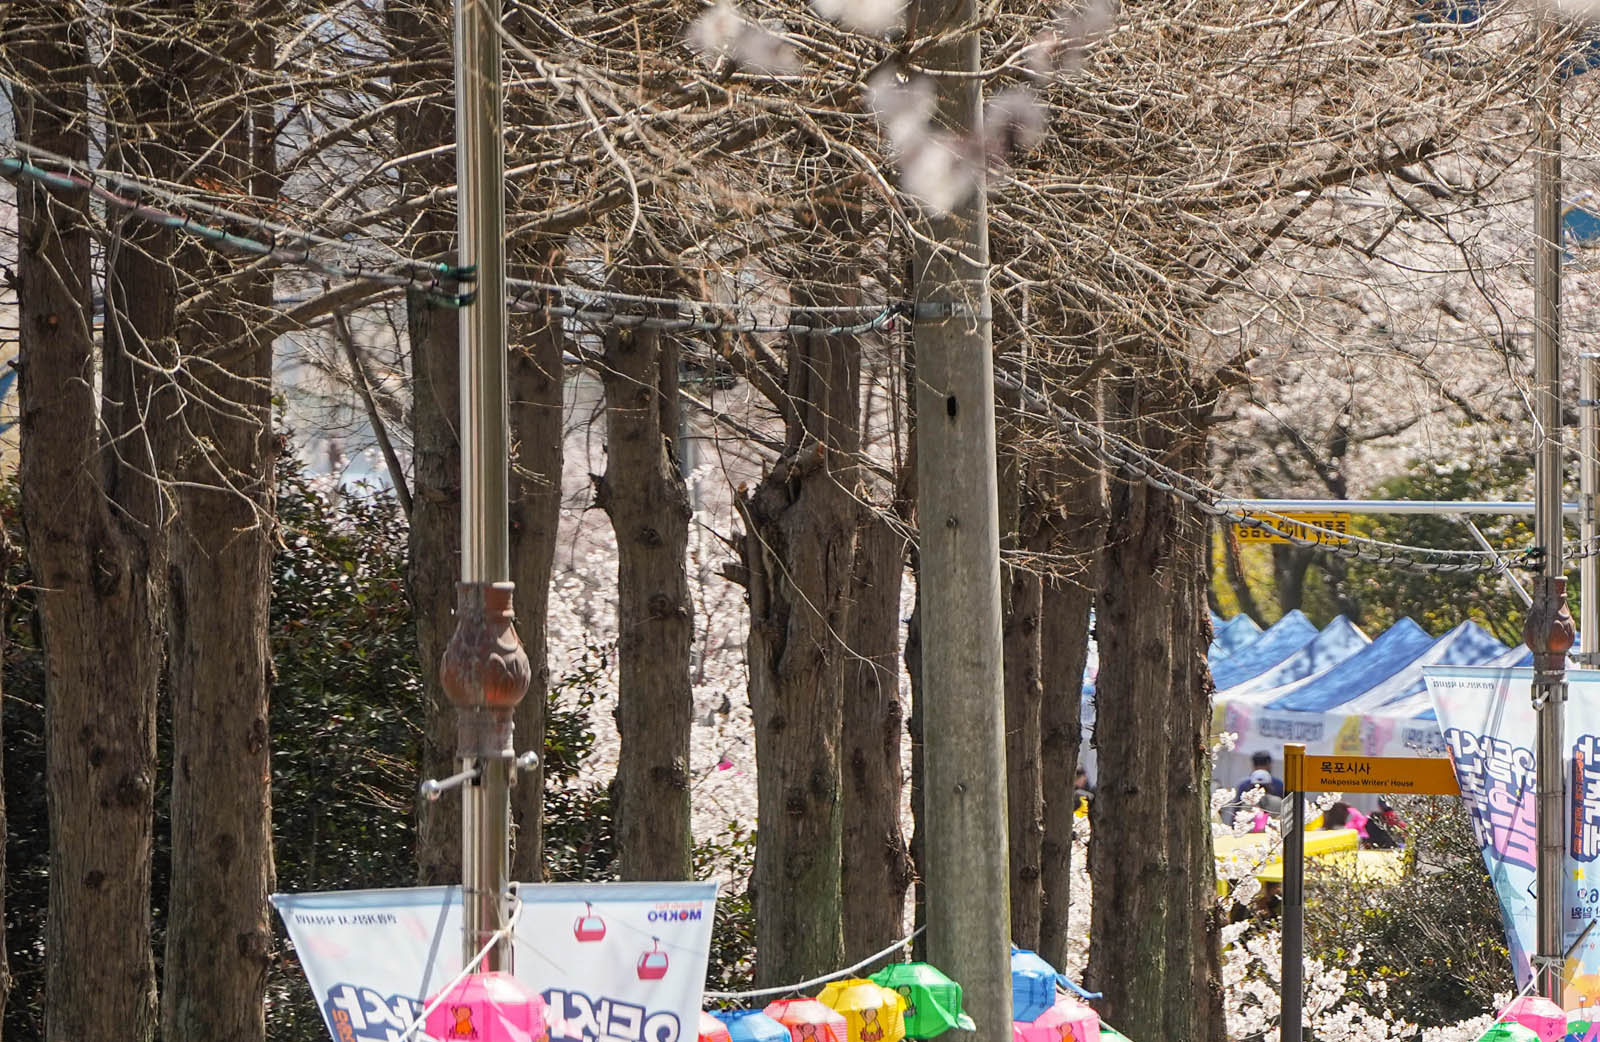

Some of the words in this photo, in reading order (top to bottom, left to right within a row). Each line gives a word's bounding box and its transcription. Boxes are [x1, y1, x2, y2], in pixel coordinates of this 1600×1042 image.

[1320, 761, 1371, 775] 목포시사
[1320, 777, 1360, 788] Mokposisa
[1391, 779, 1414, 788] House
